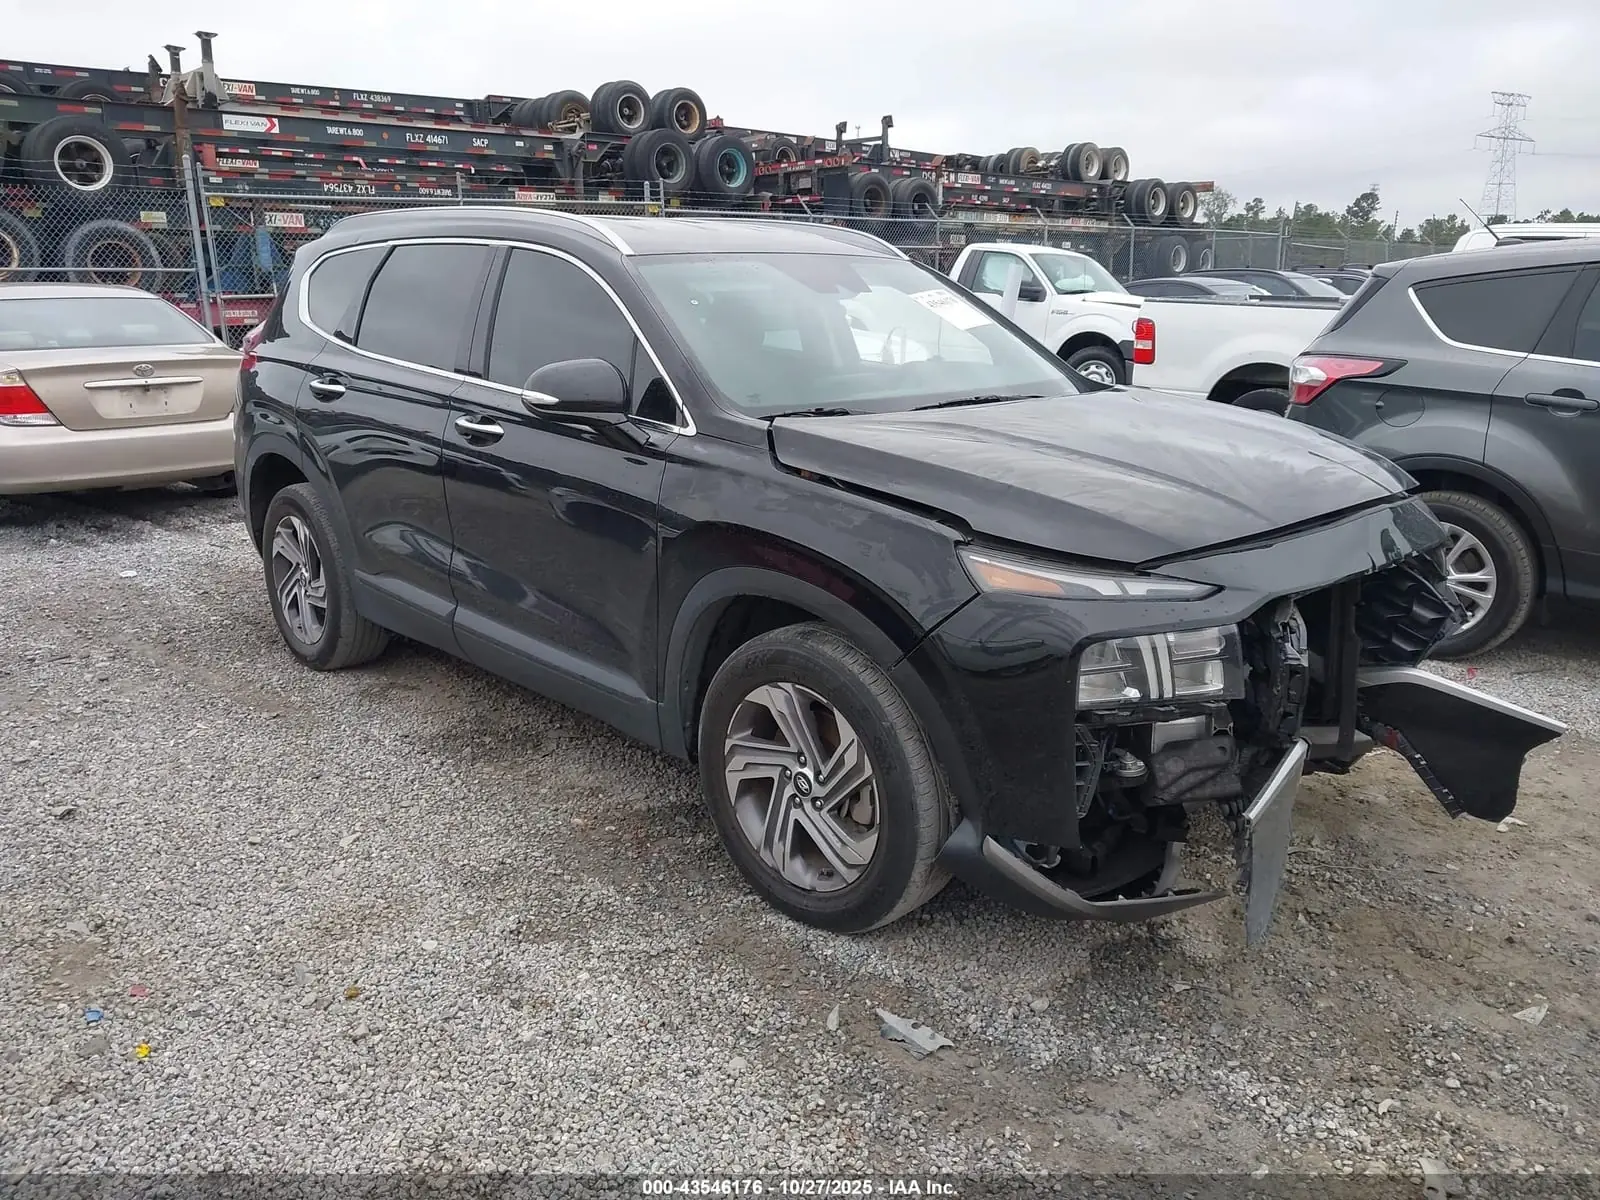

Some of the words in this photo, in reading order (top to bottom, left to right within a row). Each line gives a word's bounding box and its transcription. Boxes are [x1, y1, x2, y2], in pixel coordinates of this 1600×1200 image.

[353, 92, 368, 101] FLXZ
[405, 133, 424, 143] FLXZ
[426, 134, 448, 145] 414671
[472, 137, 489, 147] SACP
[323, 183, 354, 194] 437564
[356, 184, 376, 194] FLXZ
[266, 212, 304, 226] XI-VAN
